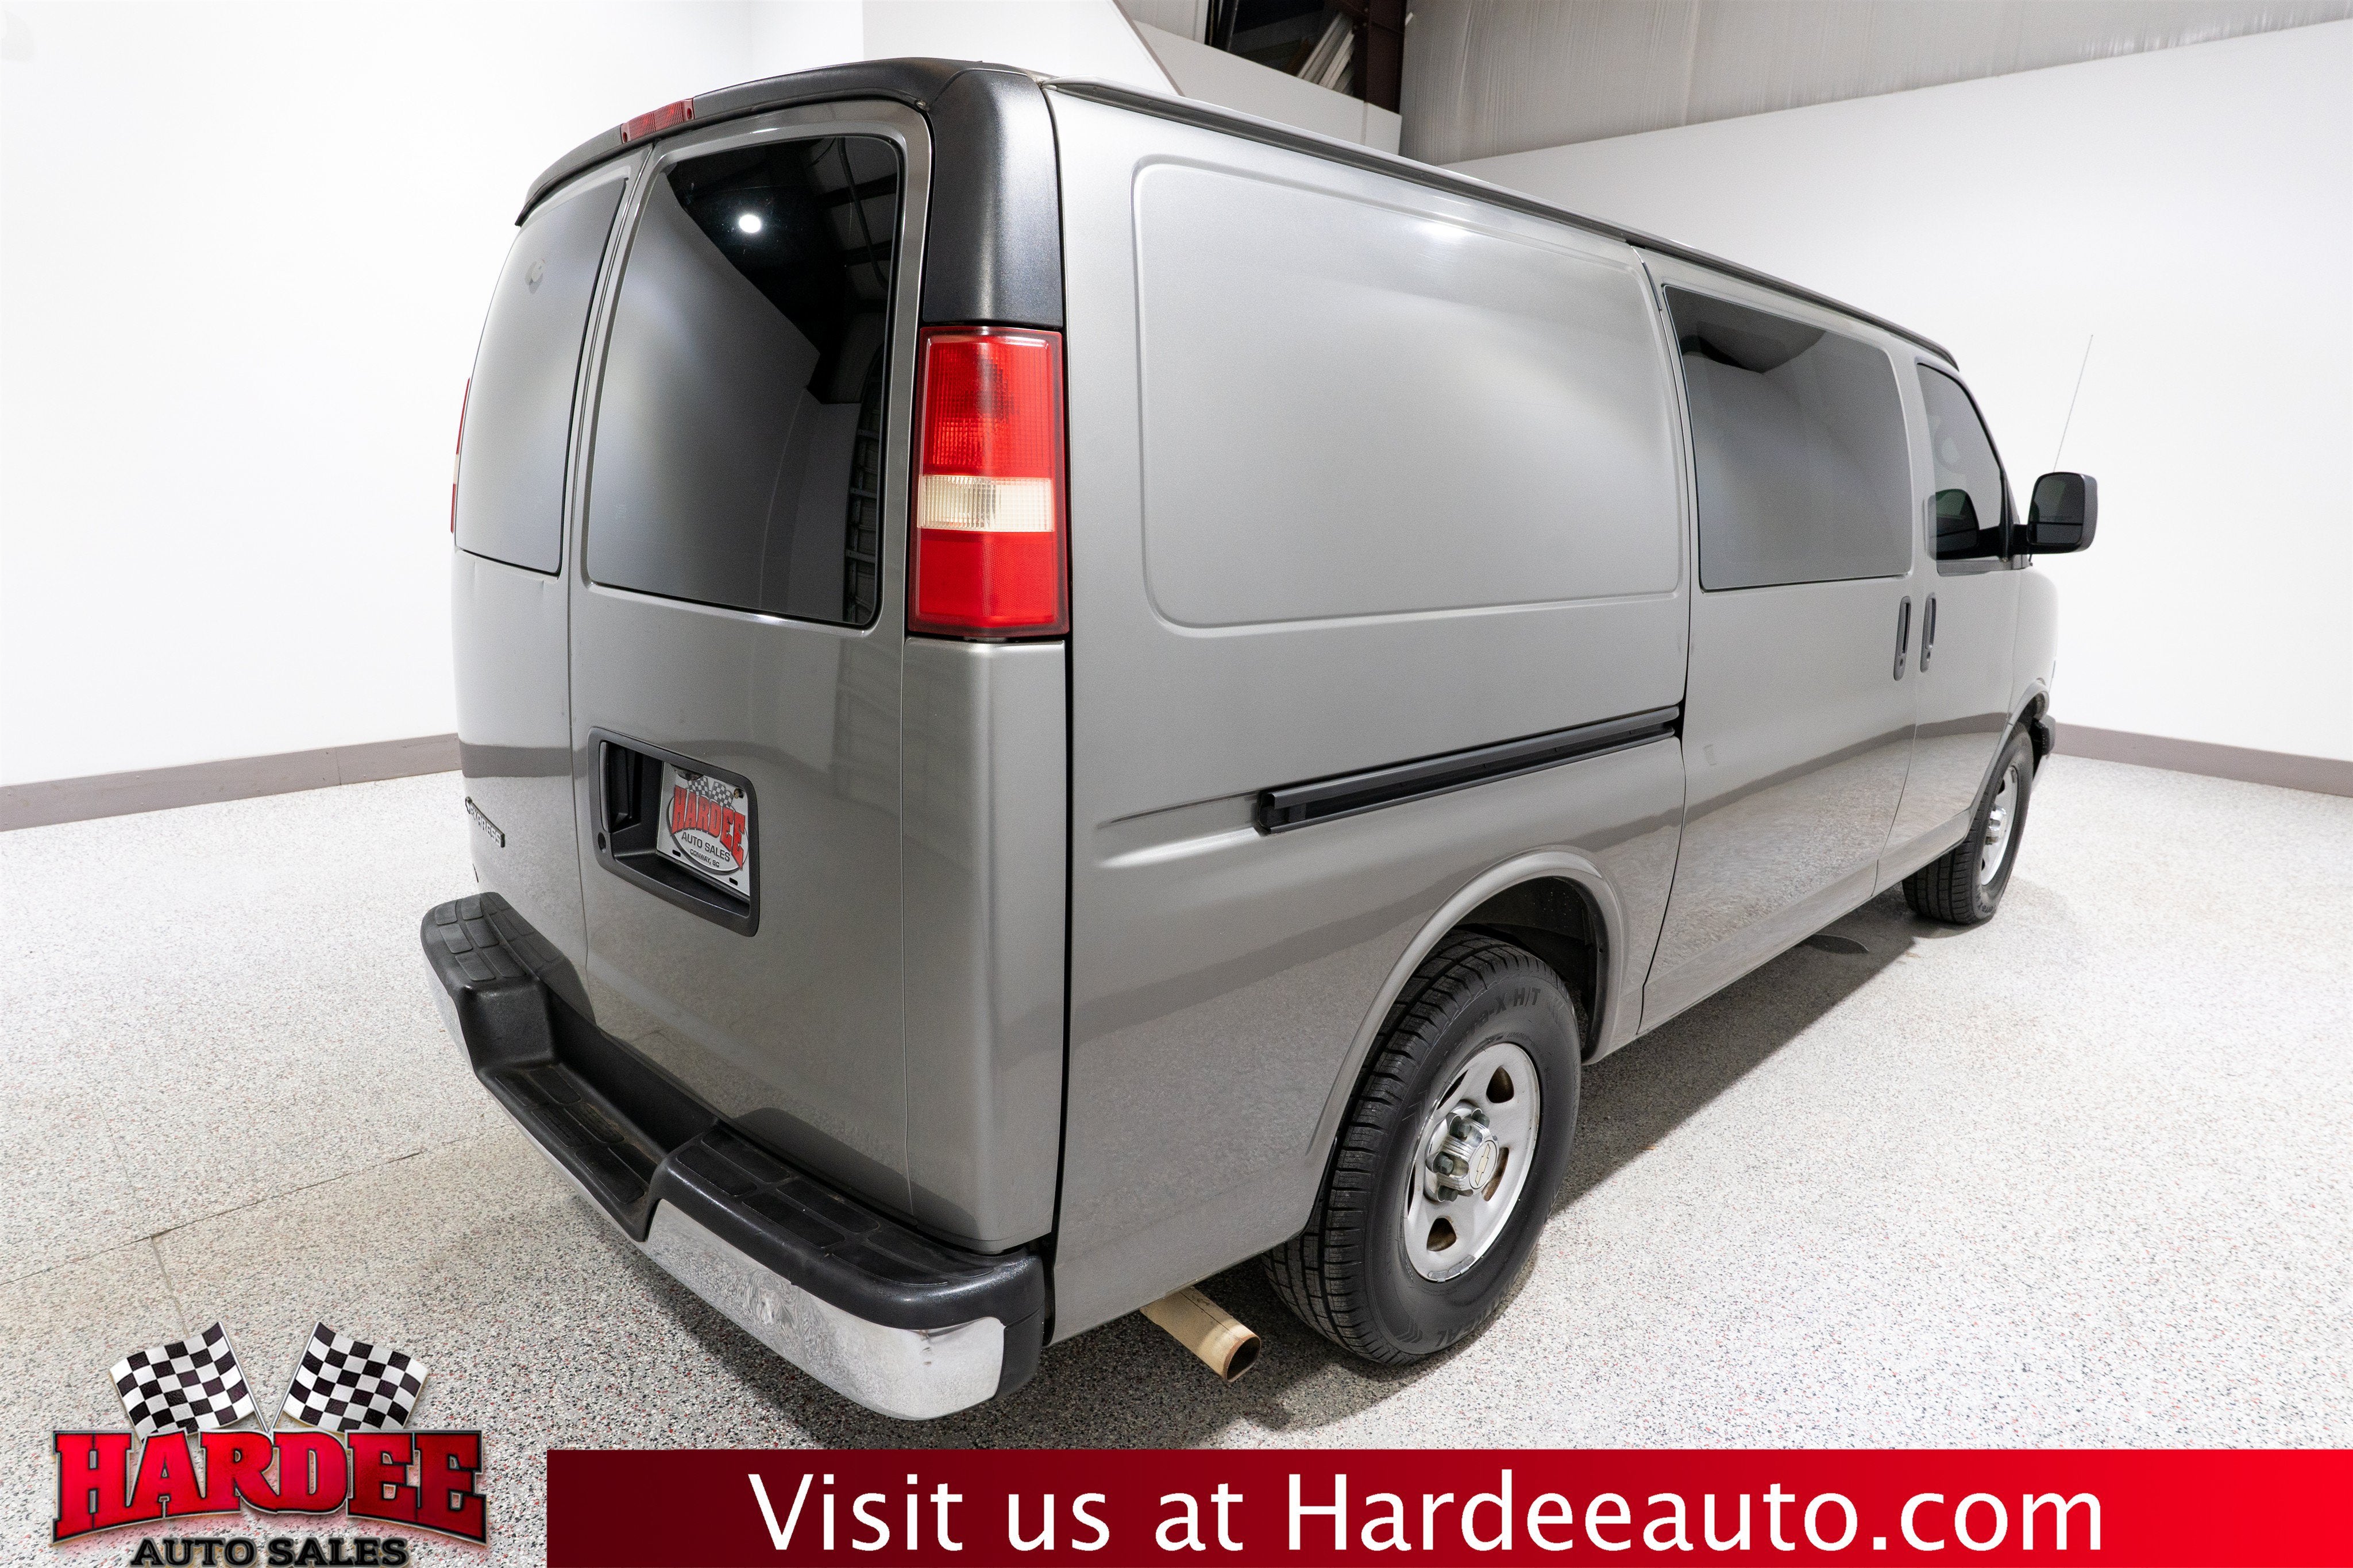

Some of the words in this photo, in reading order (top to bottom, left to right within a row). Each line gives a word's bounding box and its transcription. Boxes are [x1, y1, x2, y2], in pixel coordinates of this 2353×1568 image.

[670, 785, 746, 871] HARDEE
[681, 832, 703, 848] AUTO
[704, 843, 731, 862] SALES
[690, 848, 711, 865] CONWAY,
[712, 859, 720, 867] SC
[1513, 987, 1541, 1007] H/T
